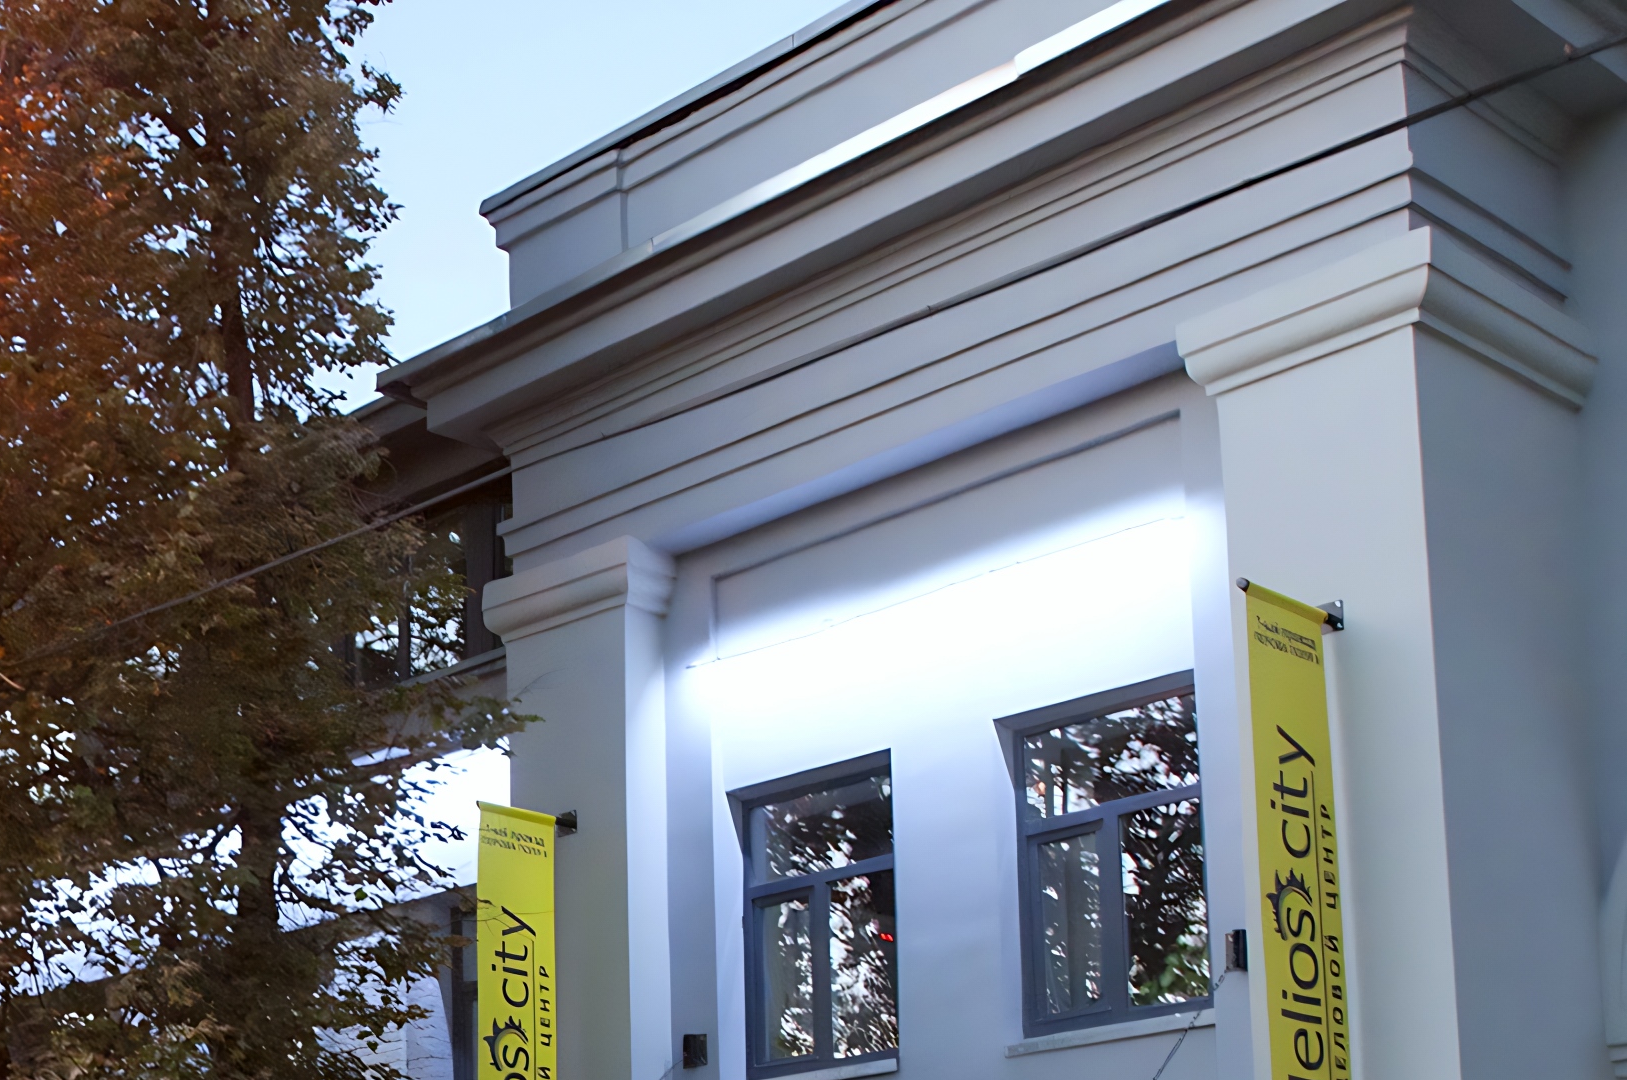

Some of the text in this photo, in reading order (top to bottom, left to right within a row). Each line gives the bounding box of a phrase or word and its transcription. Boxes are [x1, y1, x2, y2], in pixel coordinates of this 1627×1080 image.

[1270, 724, 1317, 859] city
[1320, 803, 1339, 910] ЦЕНТР
[491, 905, 537, 1008] city
[538, 965, 553, 1047] ЦЕНТР
